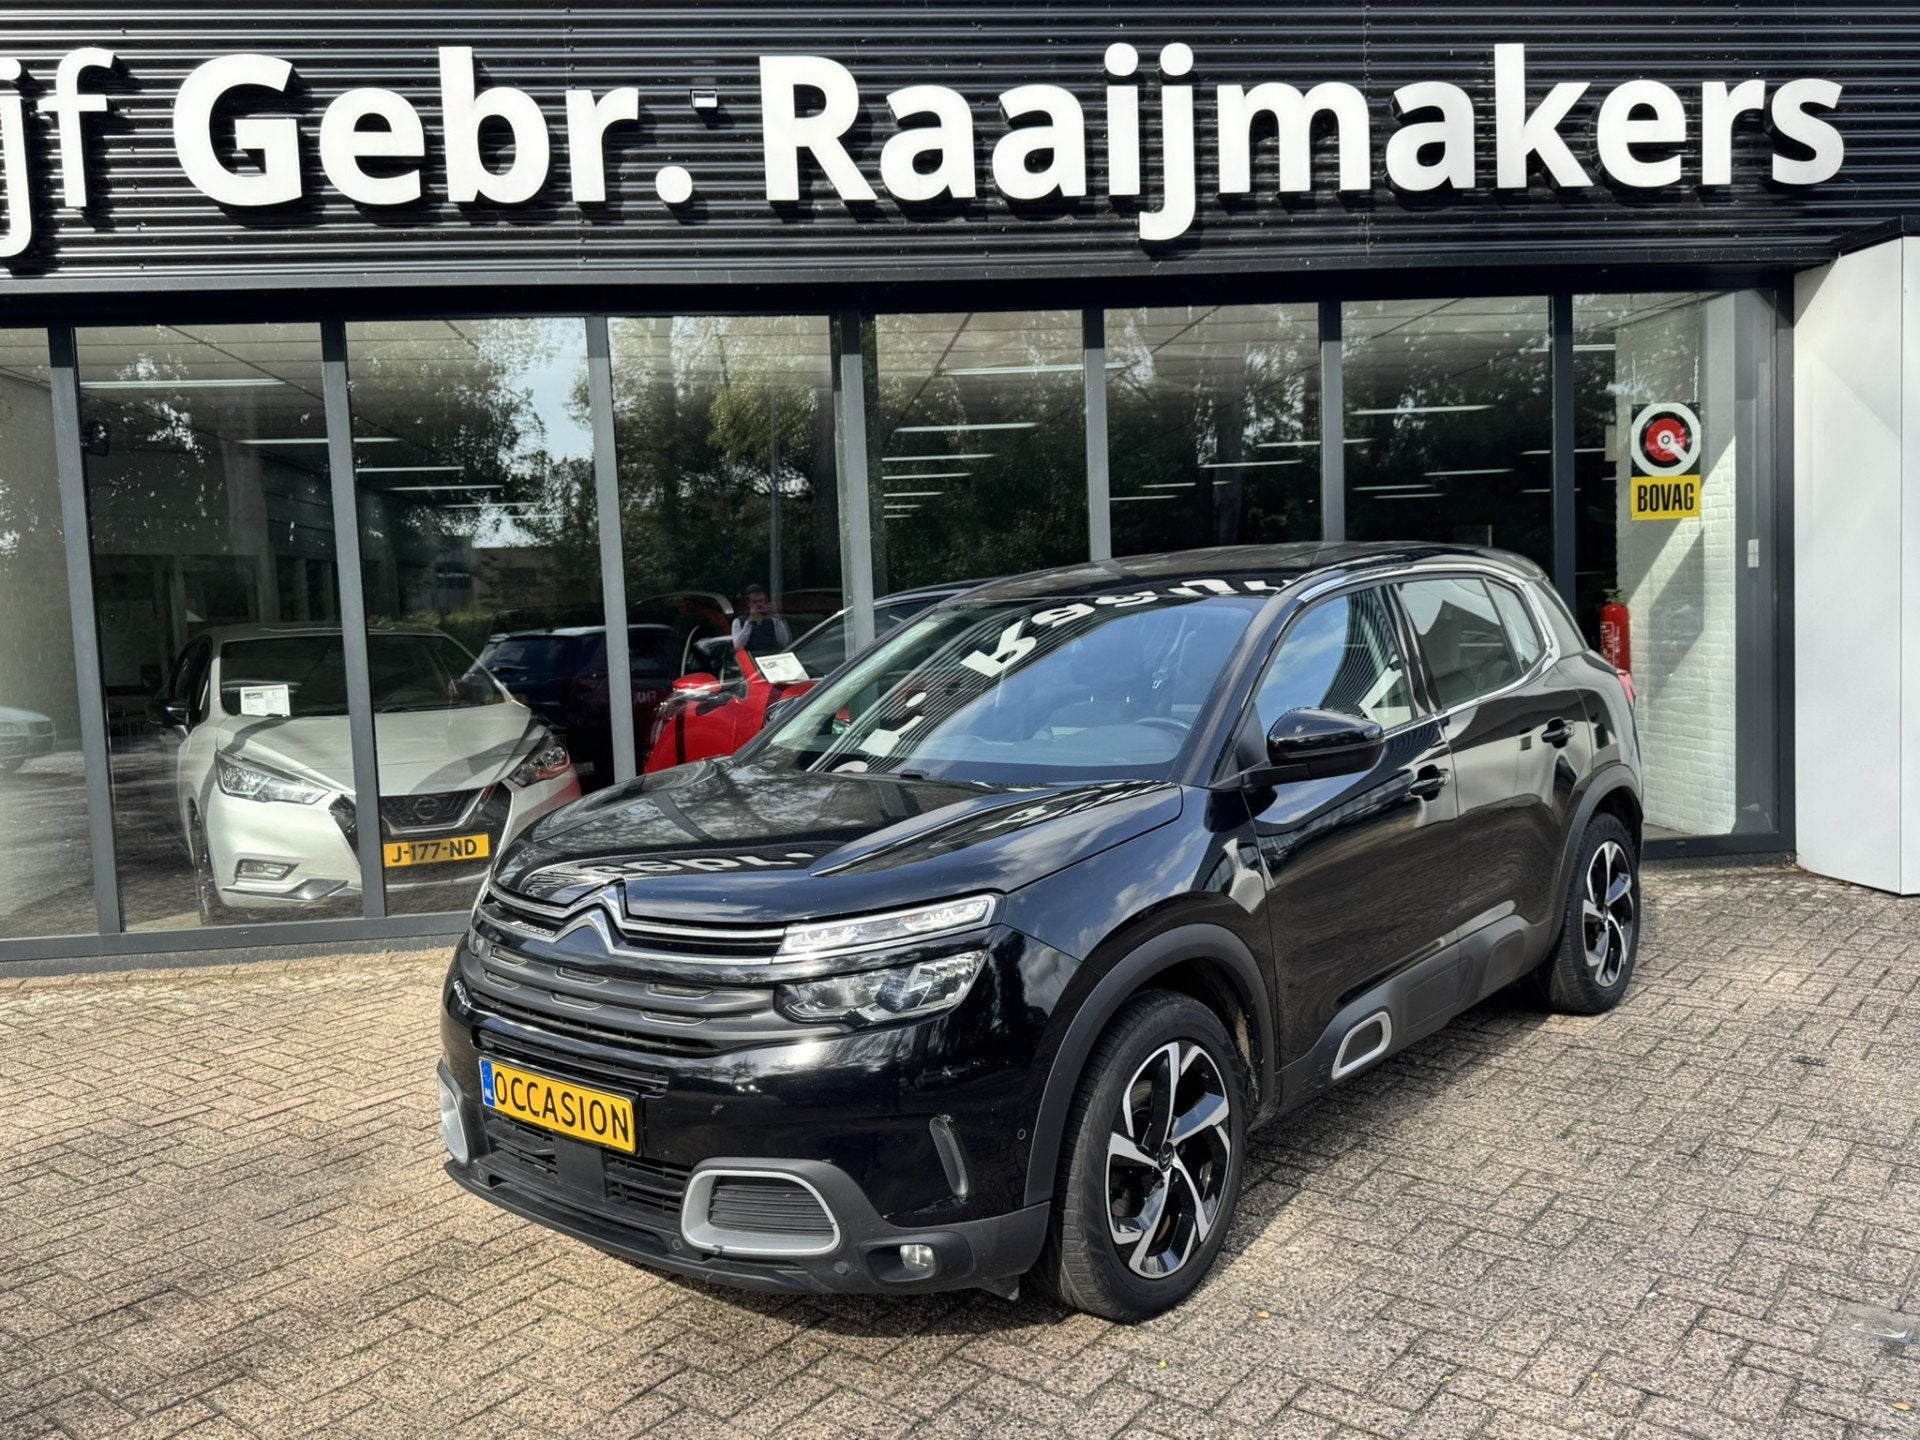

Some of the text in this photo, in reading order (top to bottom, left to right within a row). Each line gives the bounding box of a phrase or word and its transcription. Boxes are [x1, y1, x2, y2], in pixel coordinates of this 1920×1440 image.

[173, 46, 693, 206] Gebr.
[759, 42, 1845, 241] Raaijmakers
[1636, 482, 1695, 513] BOVAG
[391, 838, 478, 864] J-177-ND
[494, 1070, 630, 1143] OCCASION
